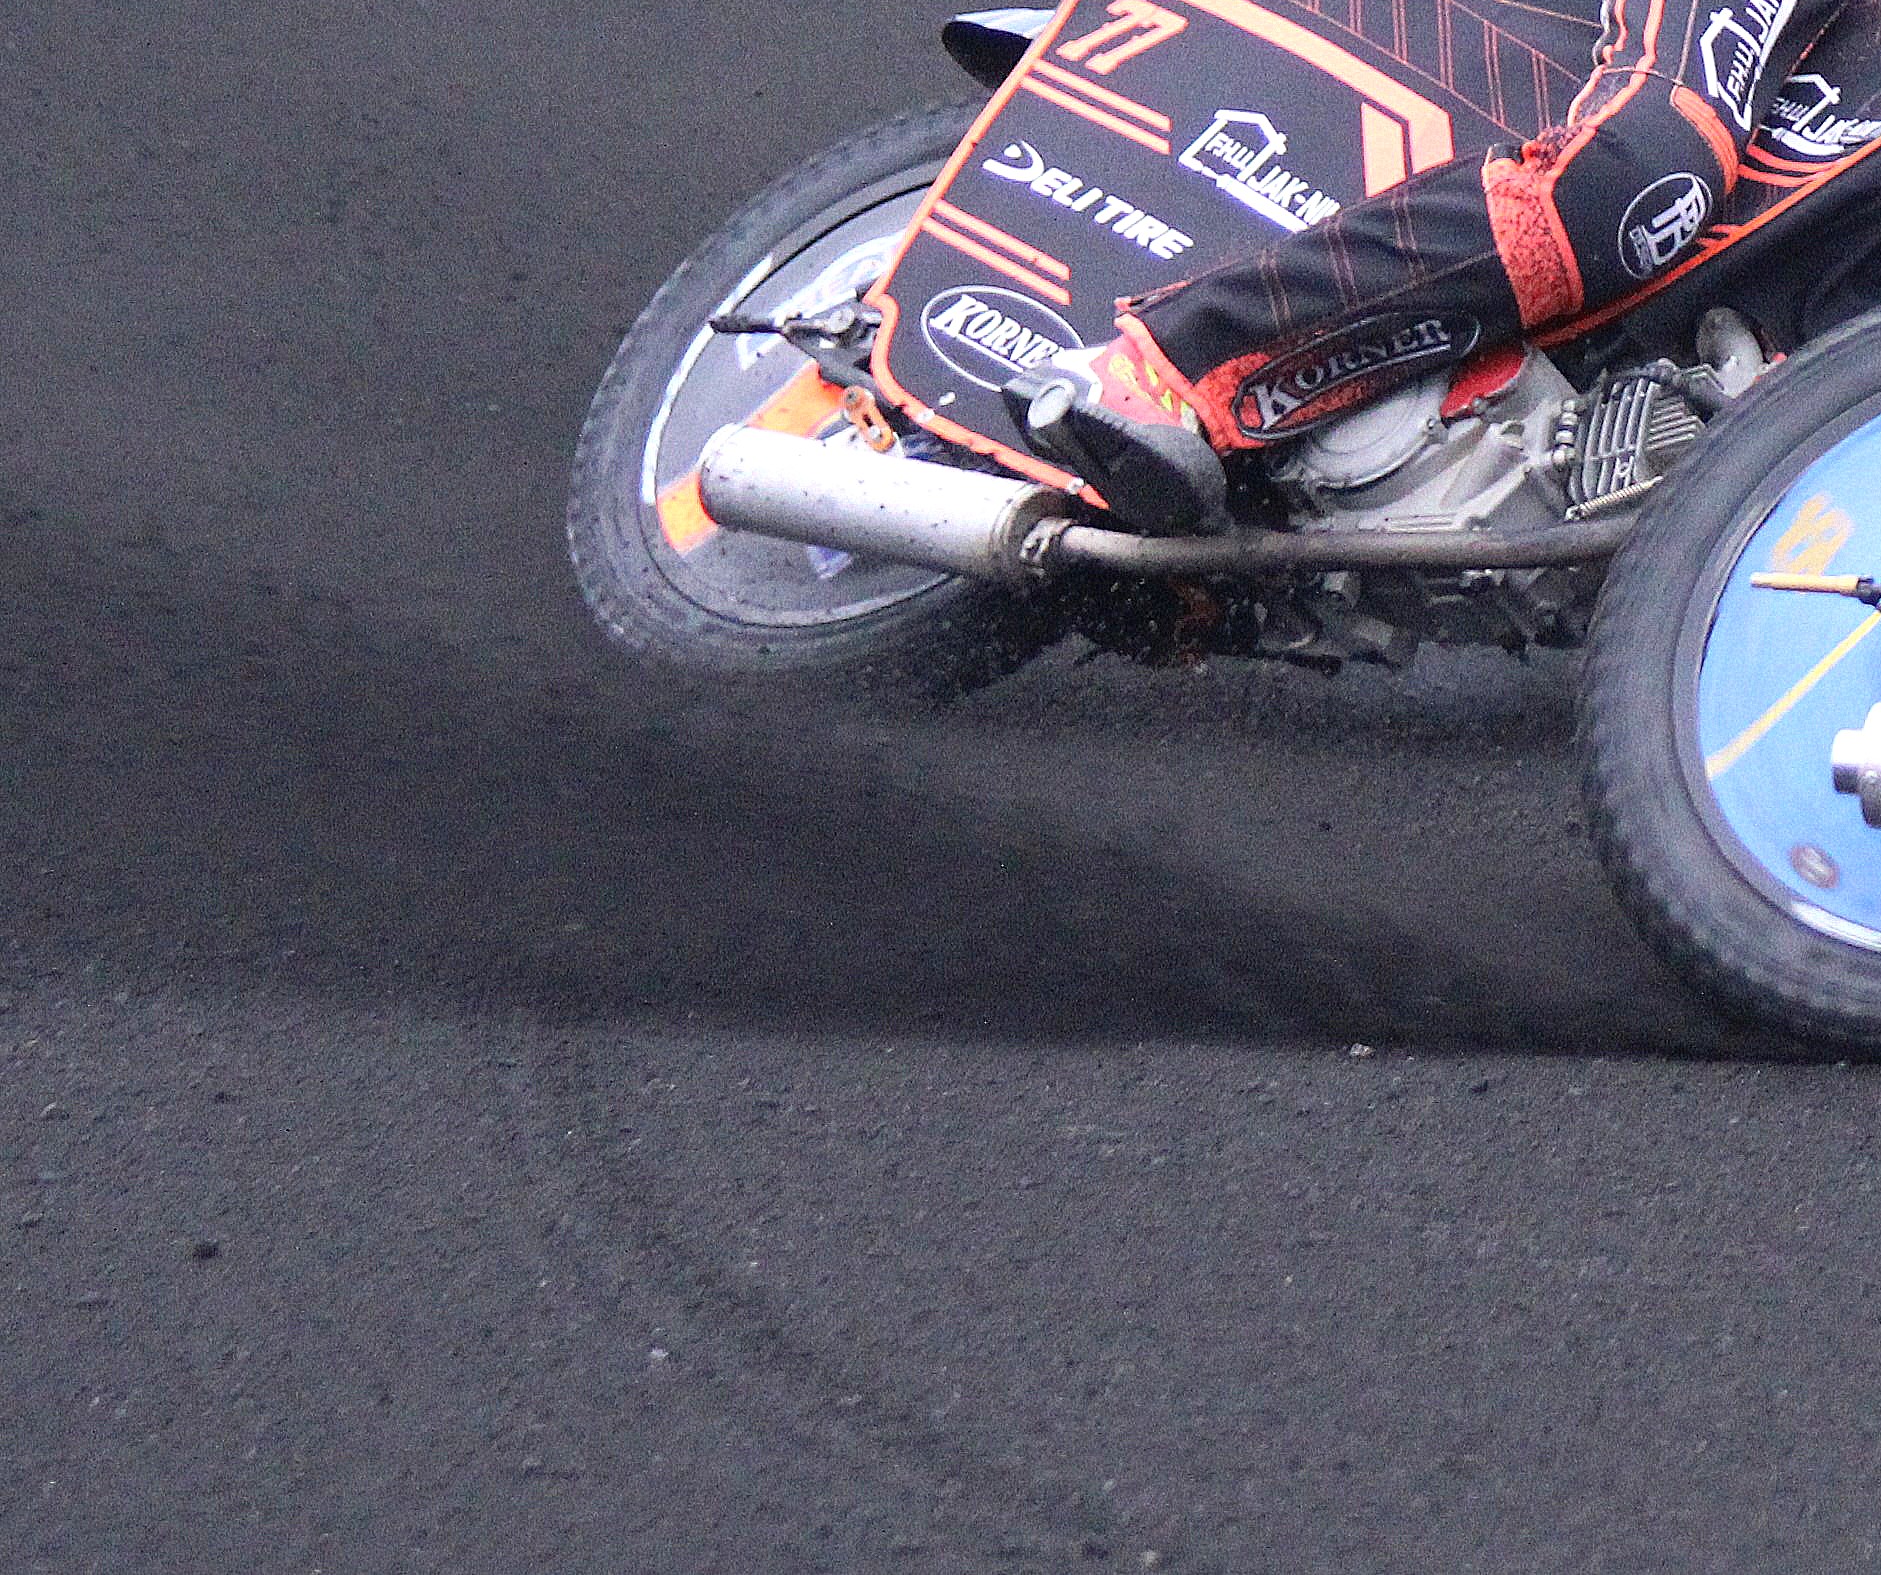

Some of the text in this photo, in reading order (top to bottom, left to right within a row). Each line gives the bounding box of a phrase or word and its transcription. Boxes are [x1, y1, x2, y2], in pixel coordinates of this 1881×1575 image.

[983, 139, 1194, 261] DELI TIRE
[929, 293, 1066, 370] KORNE
[1251, 317, 1452, 431] KORNER
